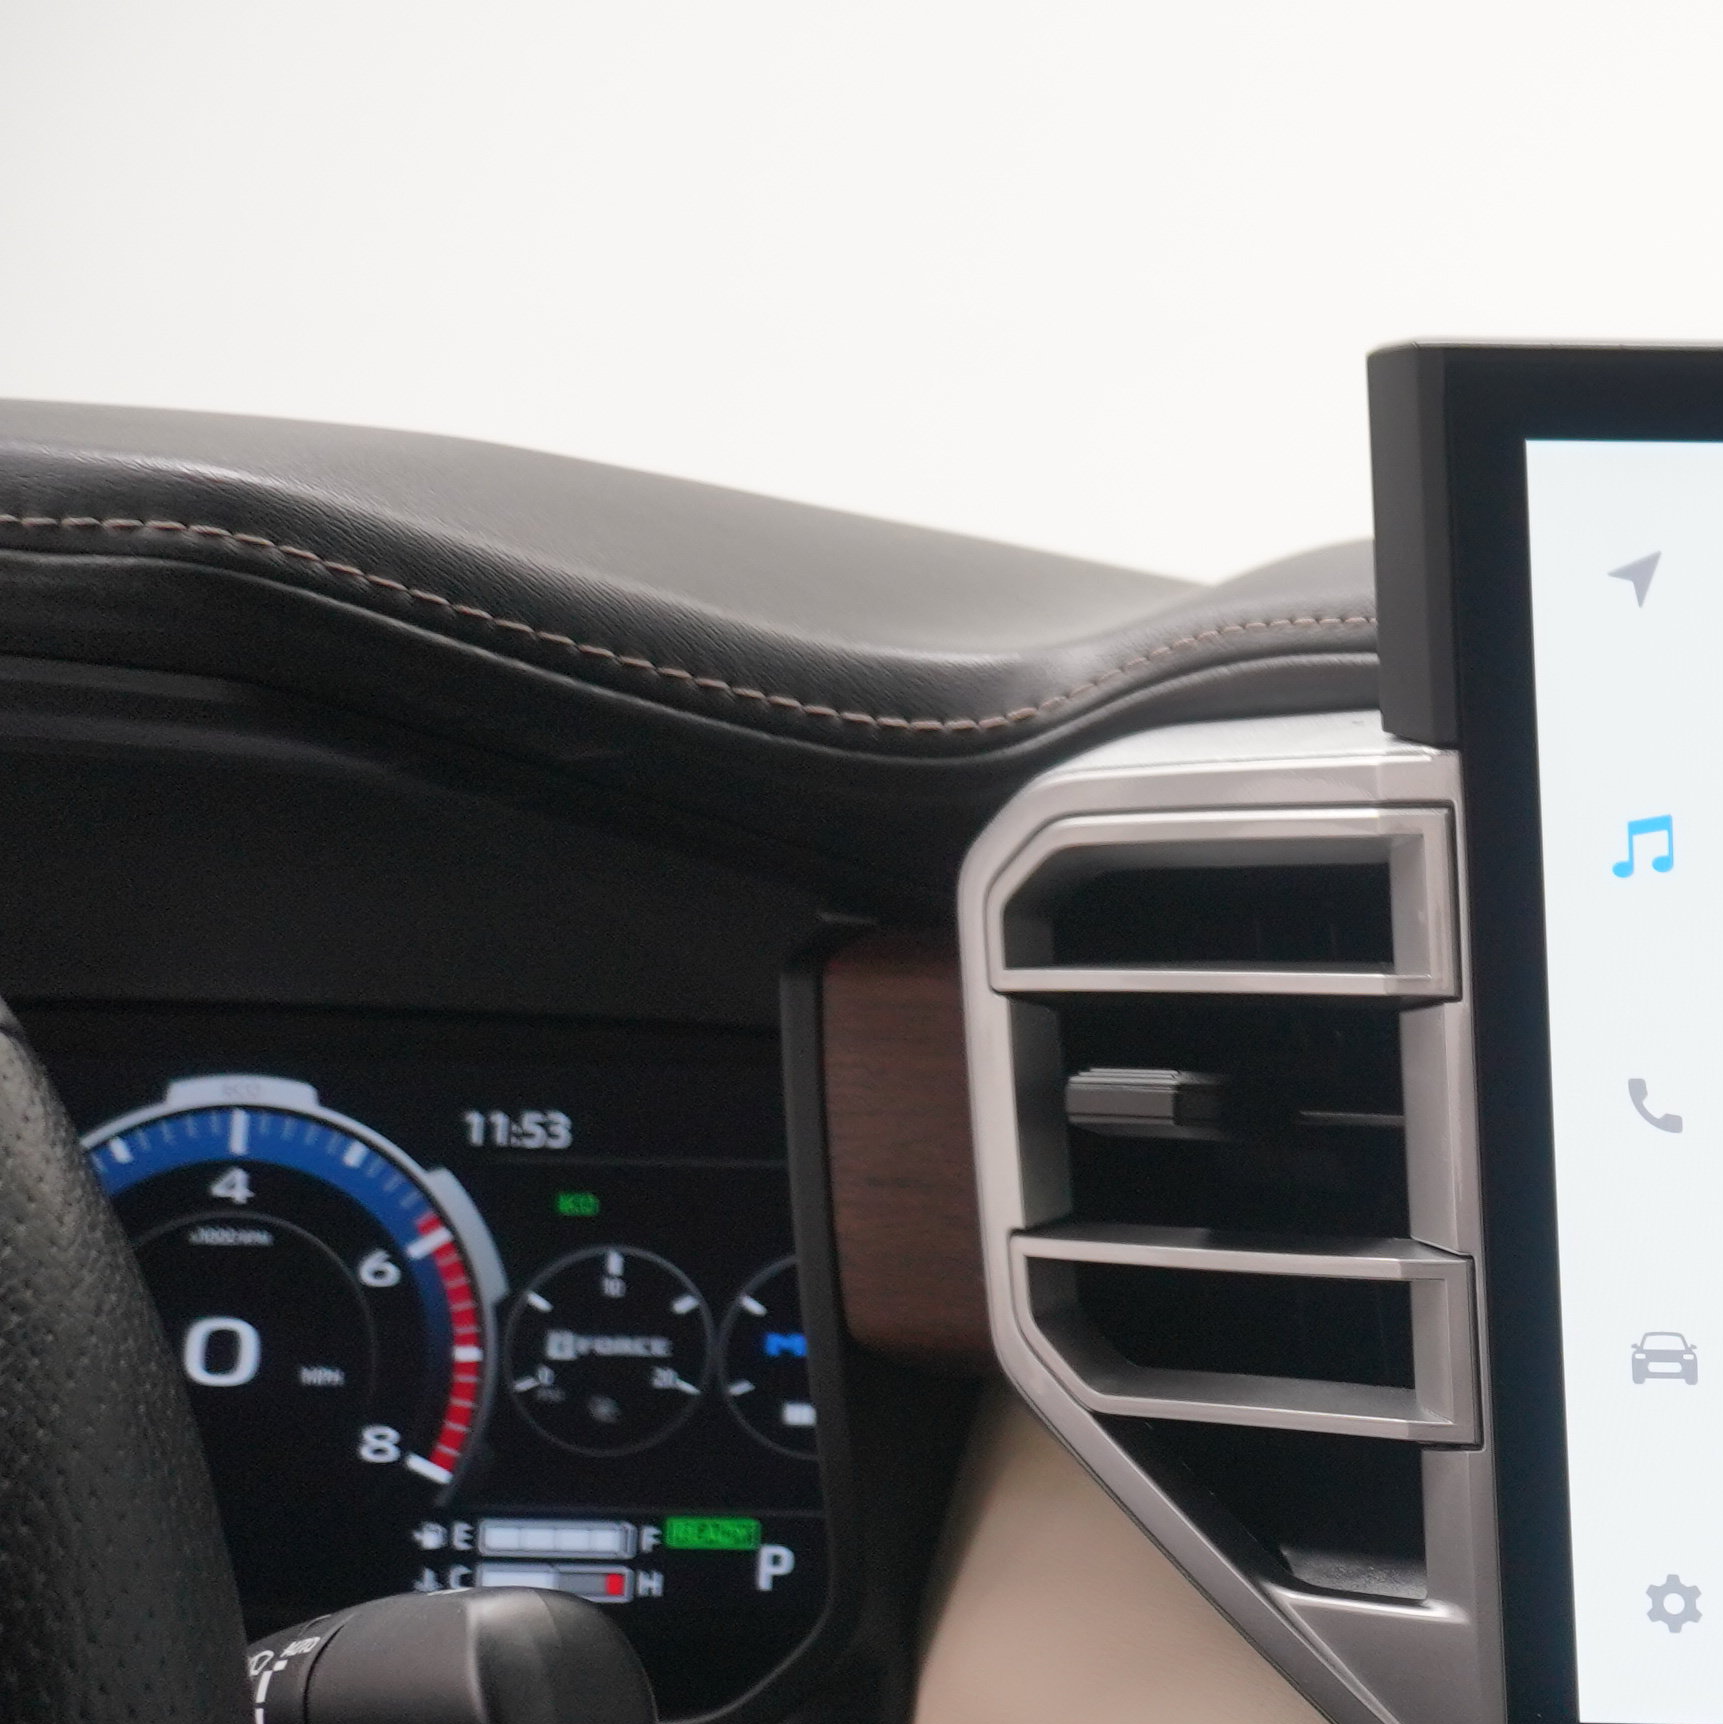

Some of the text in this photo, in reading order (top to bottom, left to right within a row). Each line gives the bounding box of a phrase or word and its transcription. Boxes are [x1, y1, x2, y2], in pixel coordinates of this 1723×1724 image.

[464, 1110, 571, 1149] 11:53
[211, 1166, 254, 1204] 4
[359, 1250, 401, 1287] 6
[184, 1316, 260, 1387] 0
[359, 1426, 399, 1462] 8
[452, 1522, 473, 1549] E
[640, 1525, 662, 1552] F
[637, 1570, 663, 1597] H
[756, 1544, 795, 1591] P
